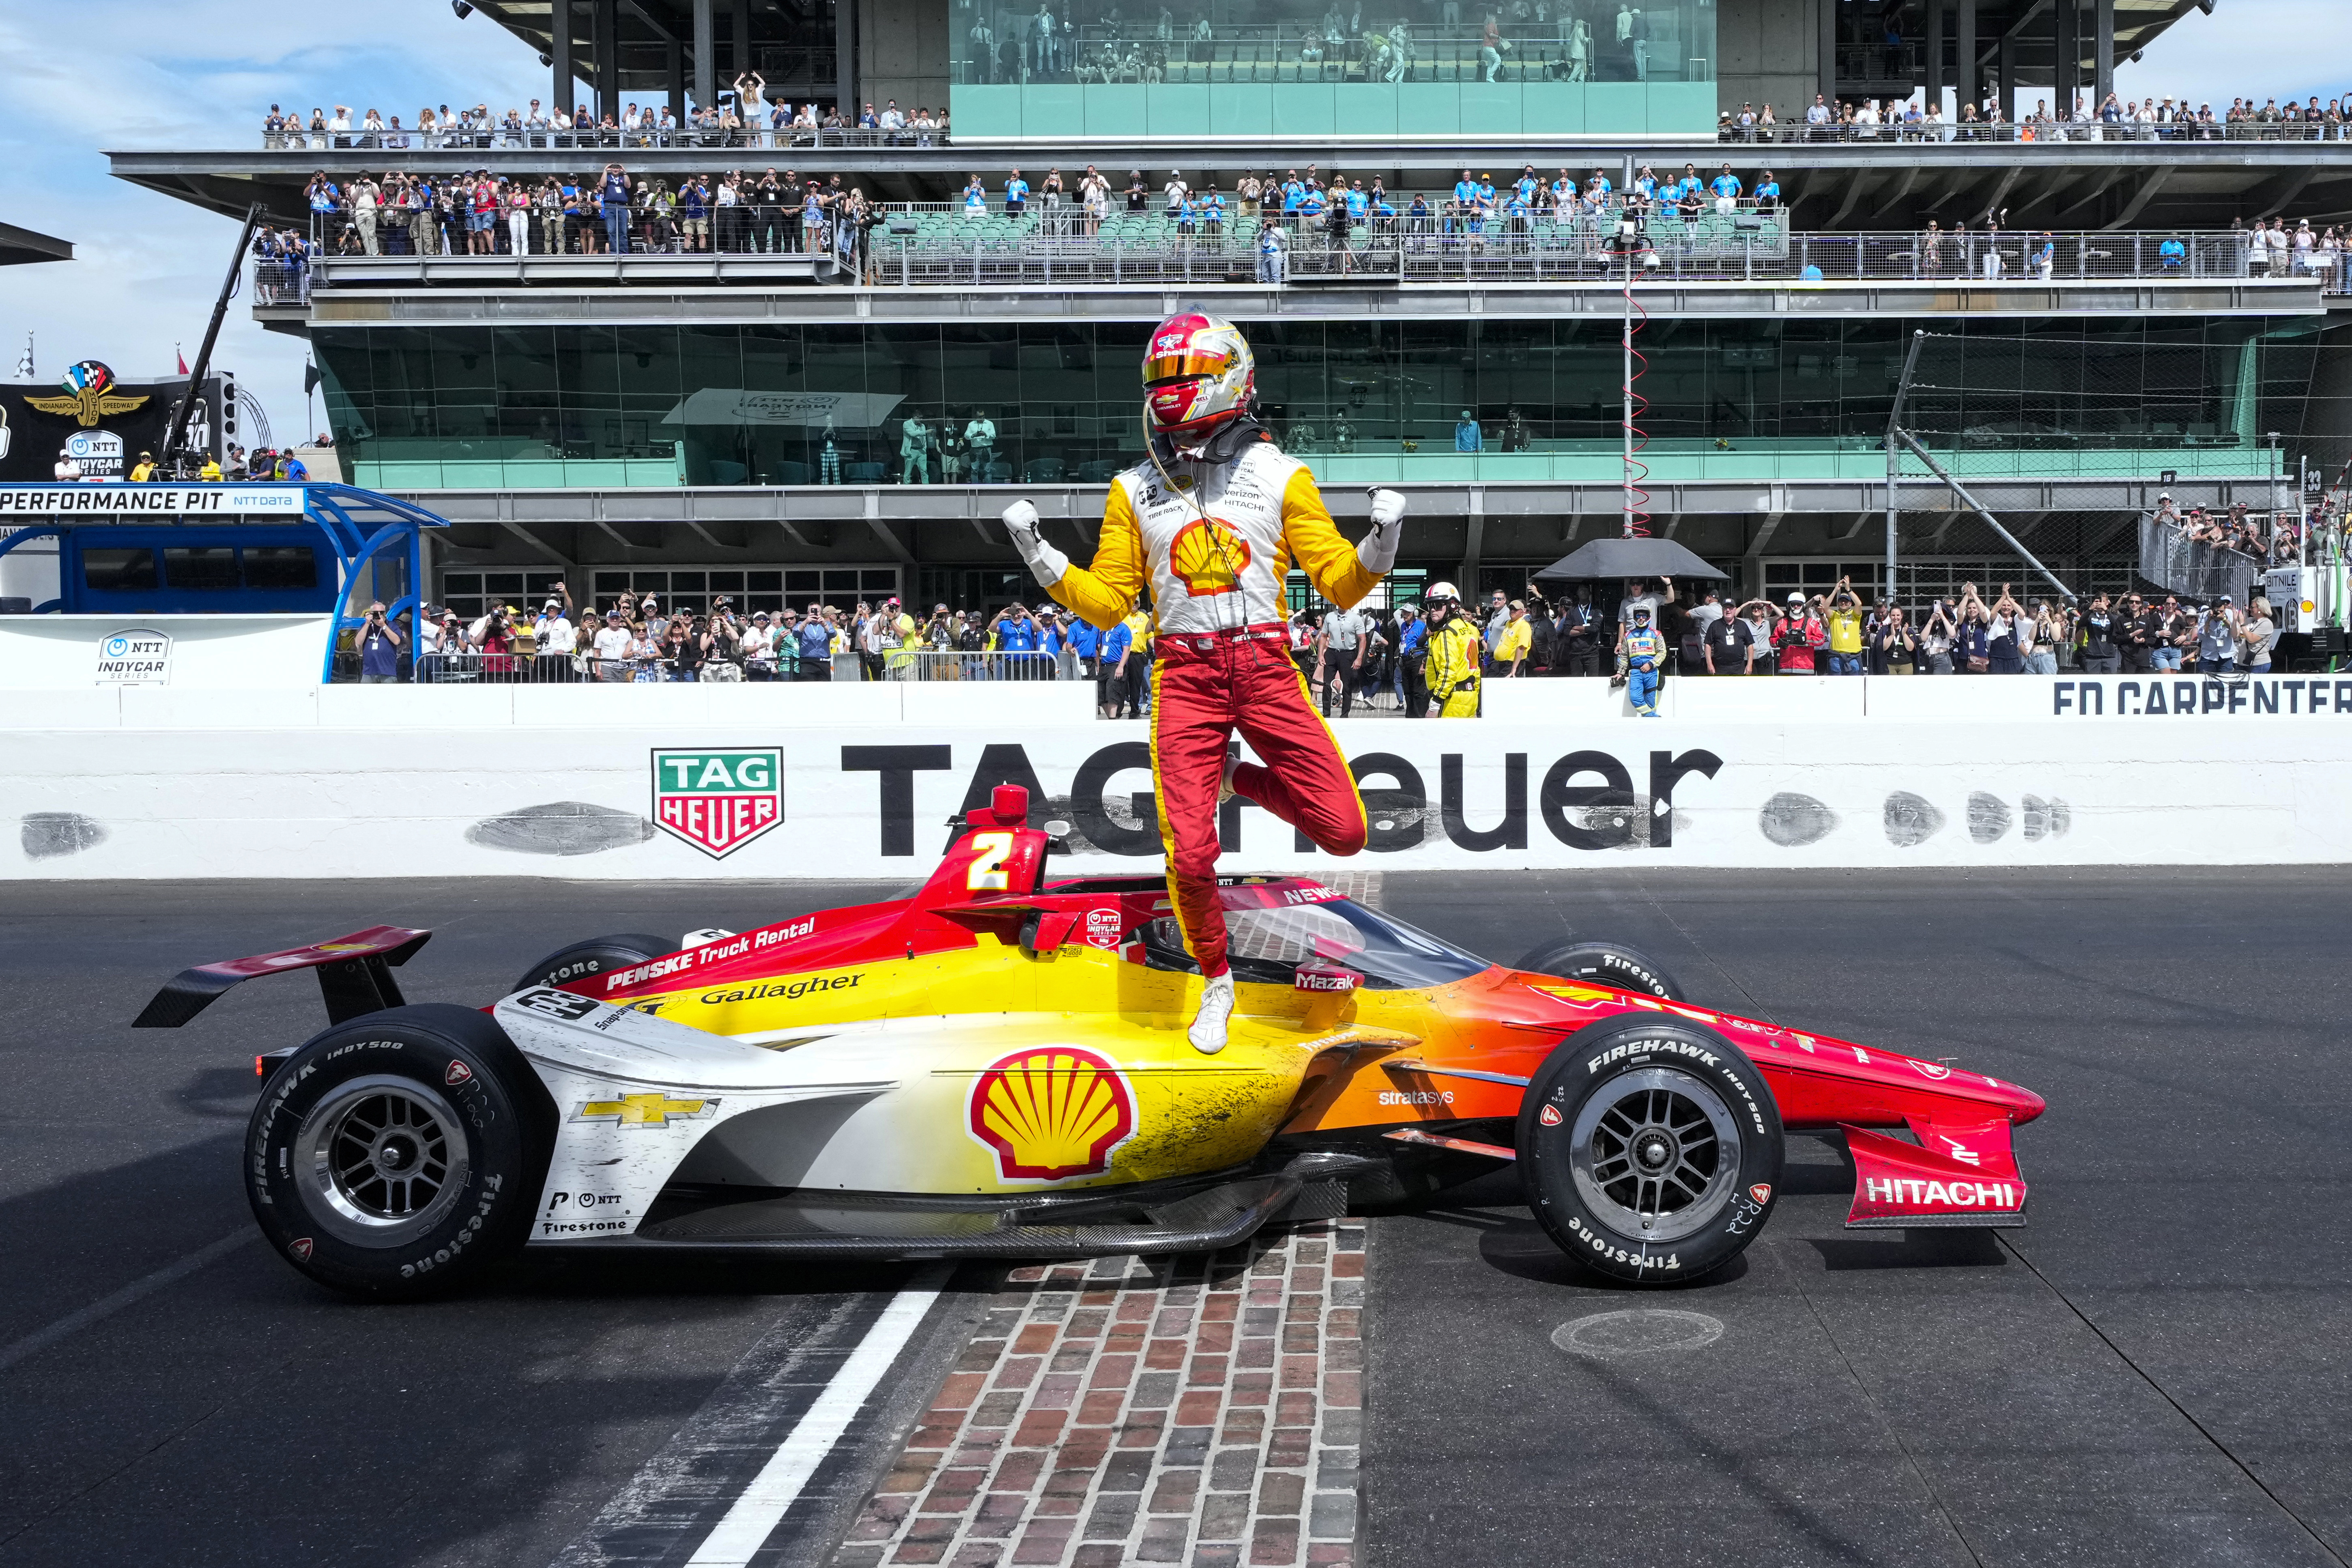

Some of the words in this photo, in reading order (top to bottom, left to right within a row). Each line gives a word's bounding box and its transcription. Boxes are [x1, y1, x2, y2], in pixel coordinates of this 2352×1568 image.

[1156, 348, 1187, 359] Shell
[92, 442, 117, 451] NTT
[70, 459, 123, 469] NDYCAR
[1230, 466, 1255, 474] INDYCAR
[2163, 474, 2171, 482] 16
[2307, 470, 2321, 491] 33
[0, 492, 178, 510] PERFORMANCE
[185, 492, 223, 510] PIT
[1139, 486, 1157, 504] PPG
[1224, 489, 1259, 500] verizon
[1148, 508, 1164, 520] TIRE
[1163, 504, 1184, 515] RACK
[1225, 499, 1264, 512] HITACHI
[2266, 574, 2296, 587] BITNILE
[1232, 631, 1281, 642] NEWGARDEN
[131, 642, 162, 652] NTT
[98, 662, 164, 672] INDYCAR
[665, 758, 769, 788] TAG
[664, 797, 773, 848] HEUER
[967, 832, 1014, 890] 2
[606, 952, 694, 991] PENSKE
[699, 937, 750, 965] Truck
[755, 916, 815, 949] Rental
[700, 972, 866, 1005] Gallagher
[1295, 973, 1355, 990] Mazak
[527, 992, 589, 1017] PPG
[594, 1005, 631, 1031] Snap-on
[327, 1042, 366, 1060] INDY
[368, 1041, 404, 1050] 500
[1588, 1040, 1721, 1074] FIREHAWK
[1379, 1090, 1454, 1106] stratasys
[1722, 1068, 1752, 1103] INDY
[1748, 1102, 1765, 1134] 500
[254, 1057, 317, 1205] FIREHAWK
[598, 1195, 621, 1204] NTT
[1866, 1177, 2014, 1207] HITACHI
[400, 1173, 503, 1278] Firestone
[543, 1221, 626, 1235] Firestone
[1568, 1216, 1680, 1270] Firestone
